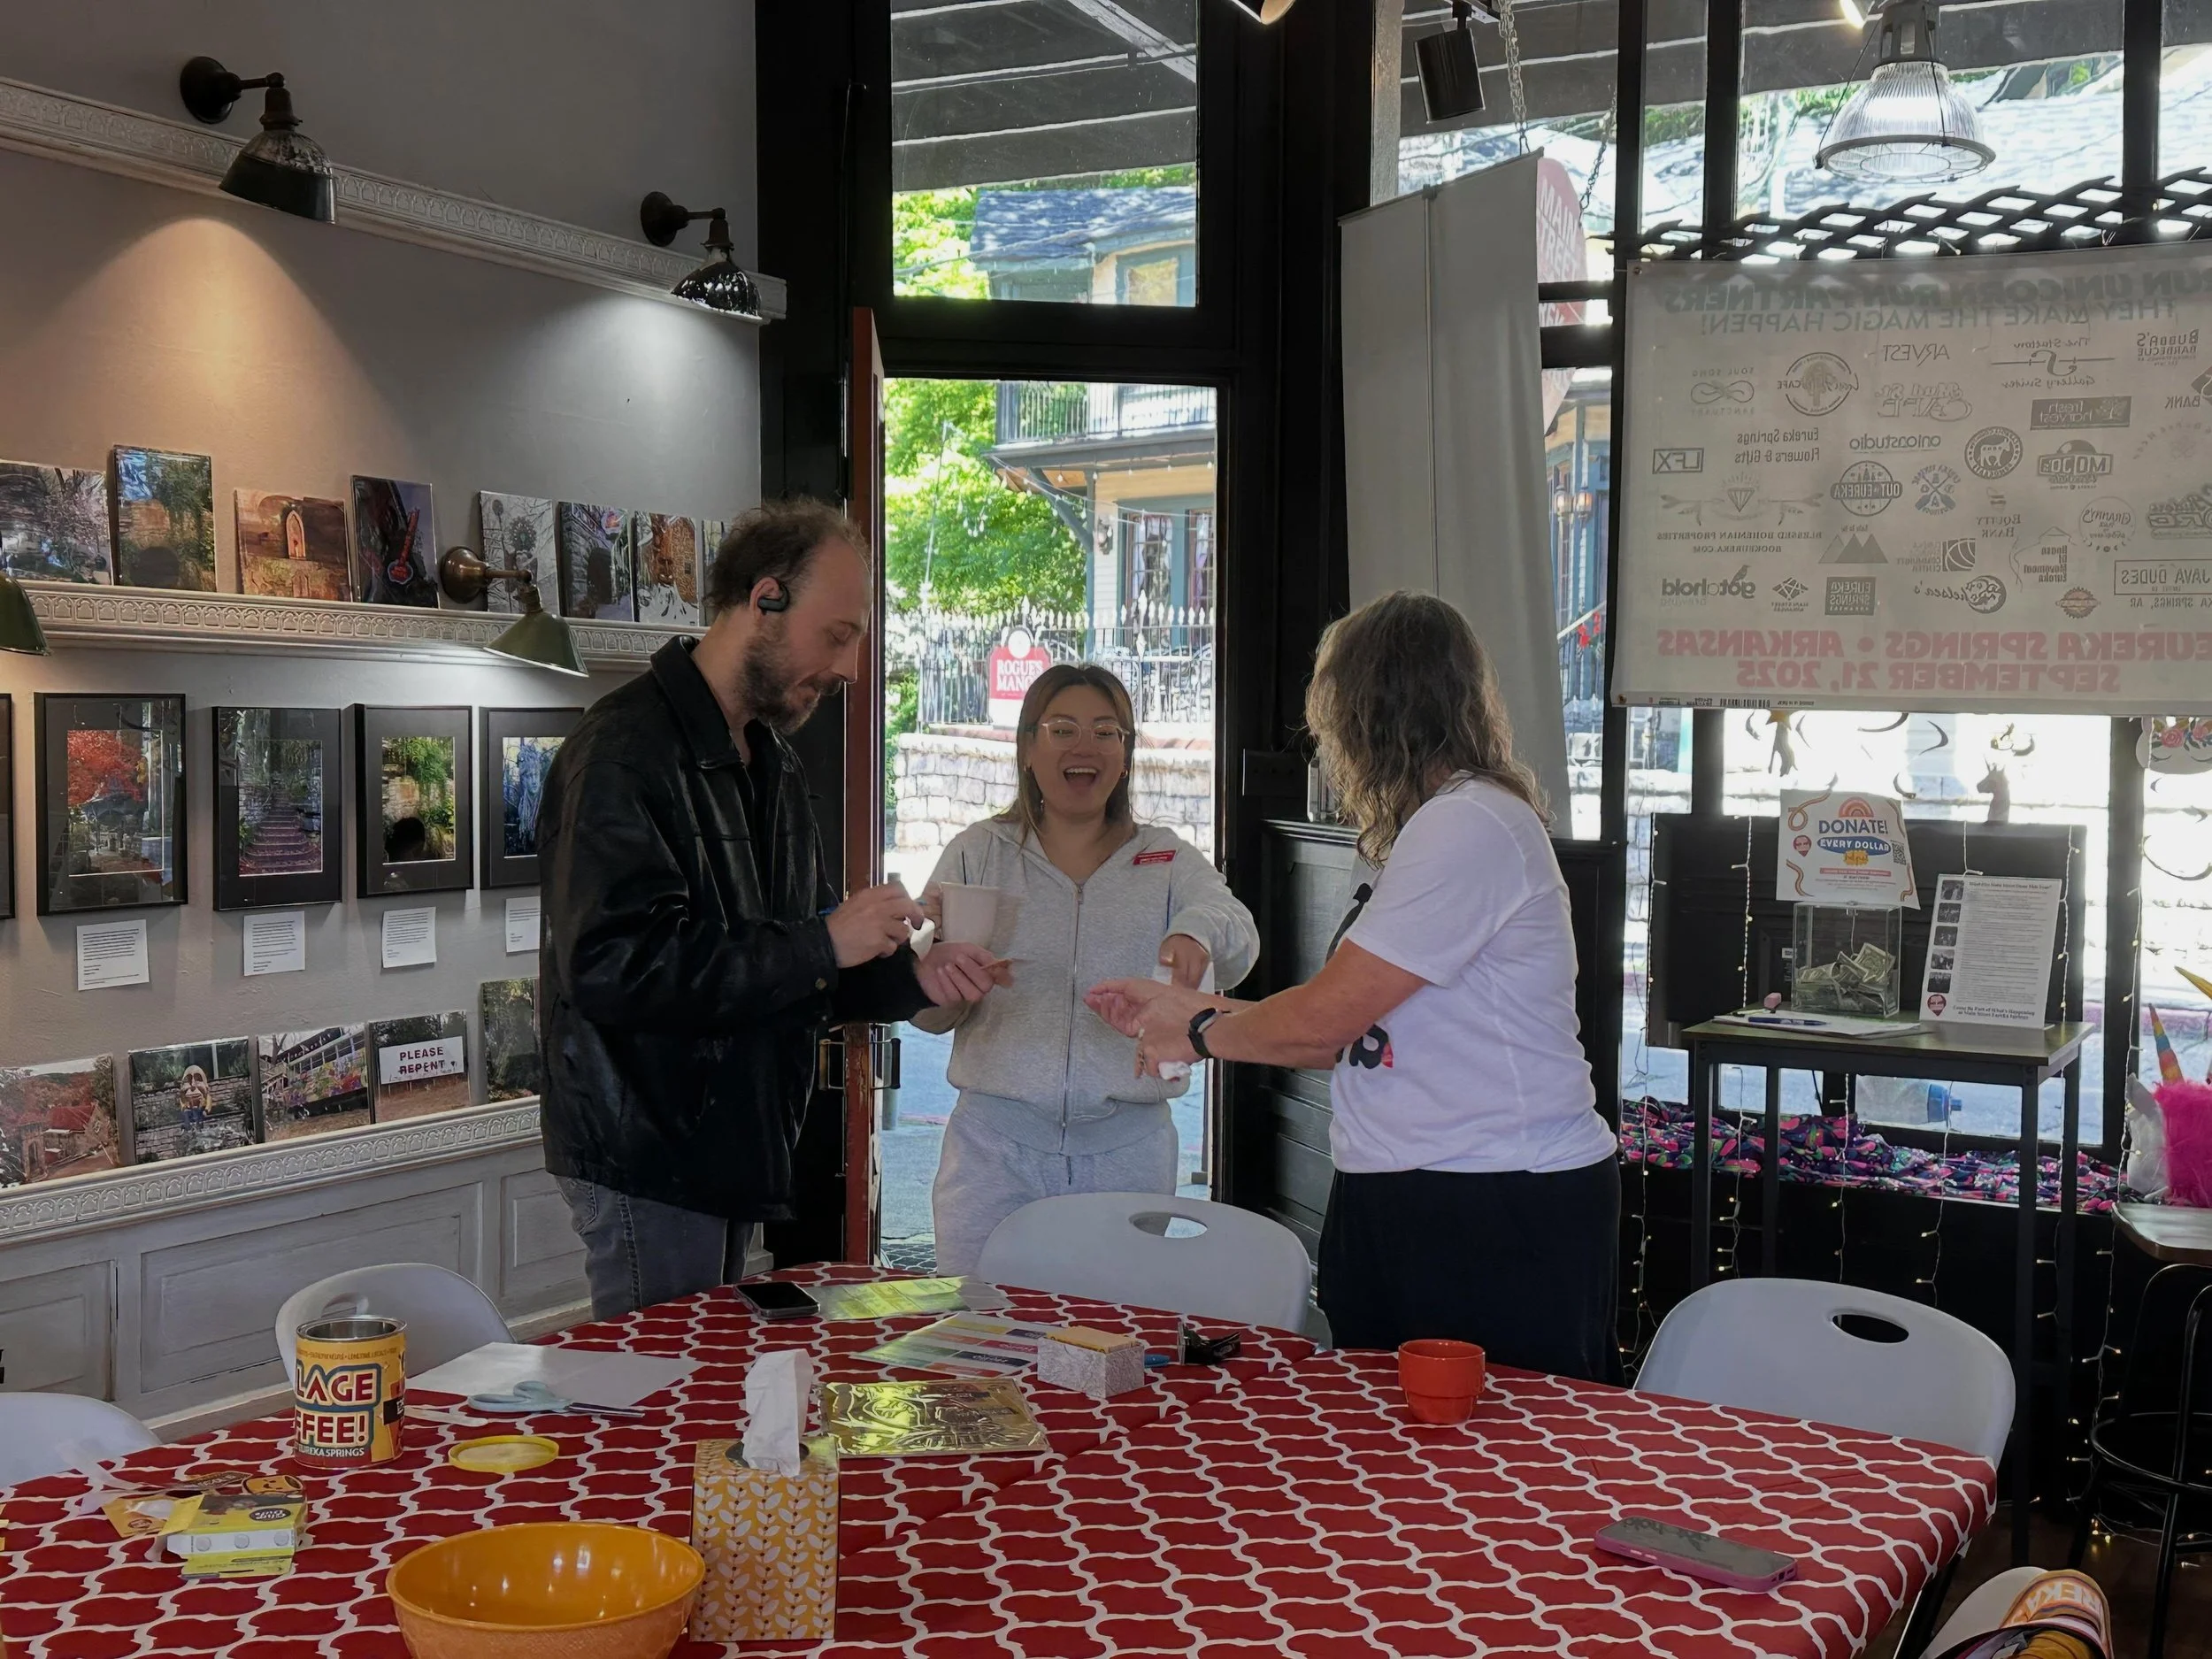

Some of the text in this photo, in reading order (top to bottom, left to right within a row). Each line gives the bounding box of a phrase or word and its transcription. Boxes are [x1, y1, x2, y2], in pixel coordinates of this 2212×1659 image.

[1540, 178, 1578, 251] MAIN
[1537, 207, 1581, 281] TREET
[1818, 819, 1889, 836] DONATE!
[1819, 838, 1853, 849] EVERY
[1854, 840, 1892, 853] DOLLAR
[399, 1046, 444, 1062] PLEASE
[325, 1447, 365, 1458] SPRINGS
